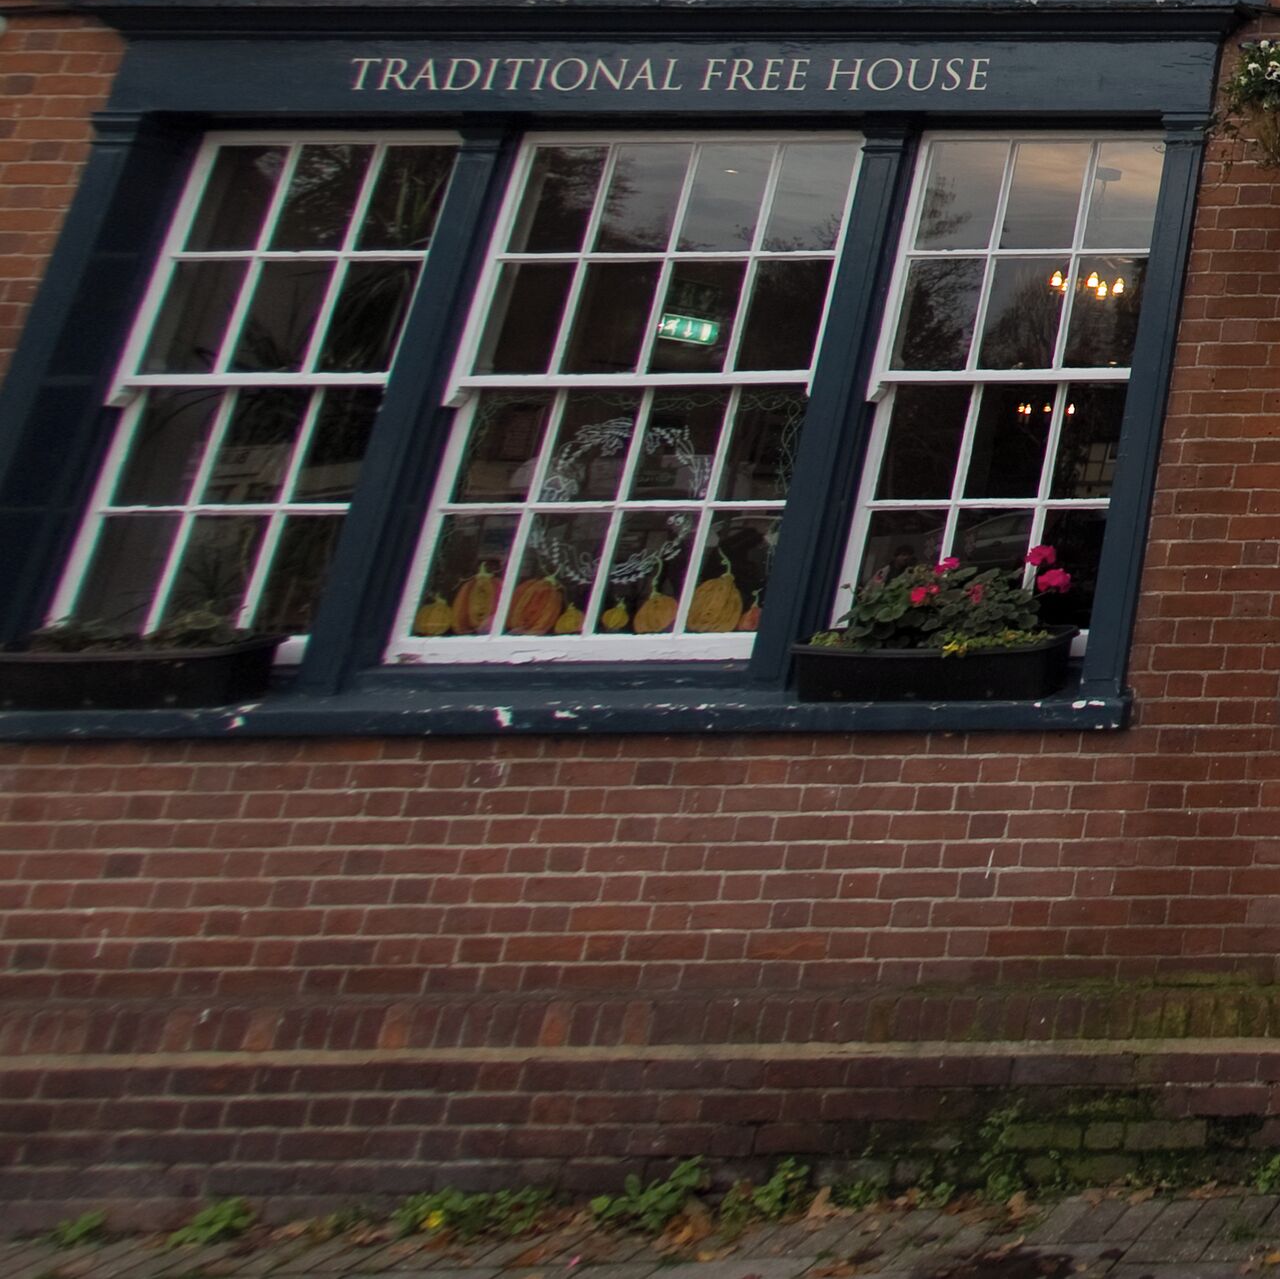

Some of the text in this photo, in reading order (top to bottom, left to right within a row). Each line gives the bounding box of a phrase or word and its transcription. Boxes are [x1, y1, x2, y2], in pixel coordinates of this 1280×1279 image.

[351, 57, 990, 91] TRADITIONAL FREE HOUSE
